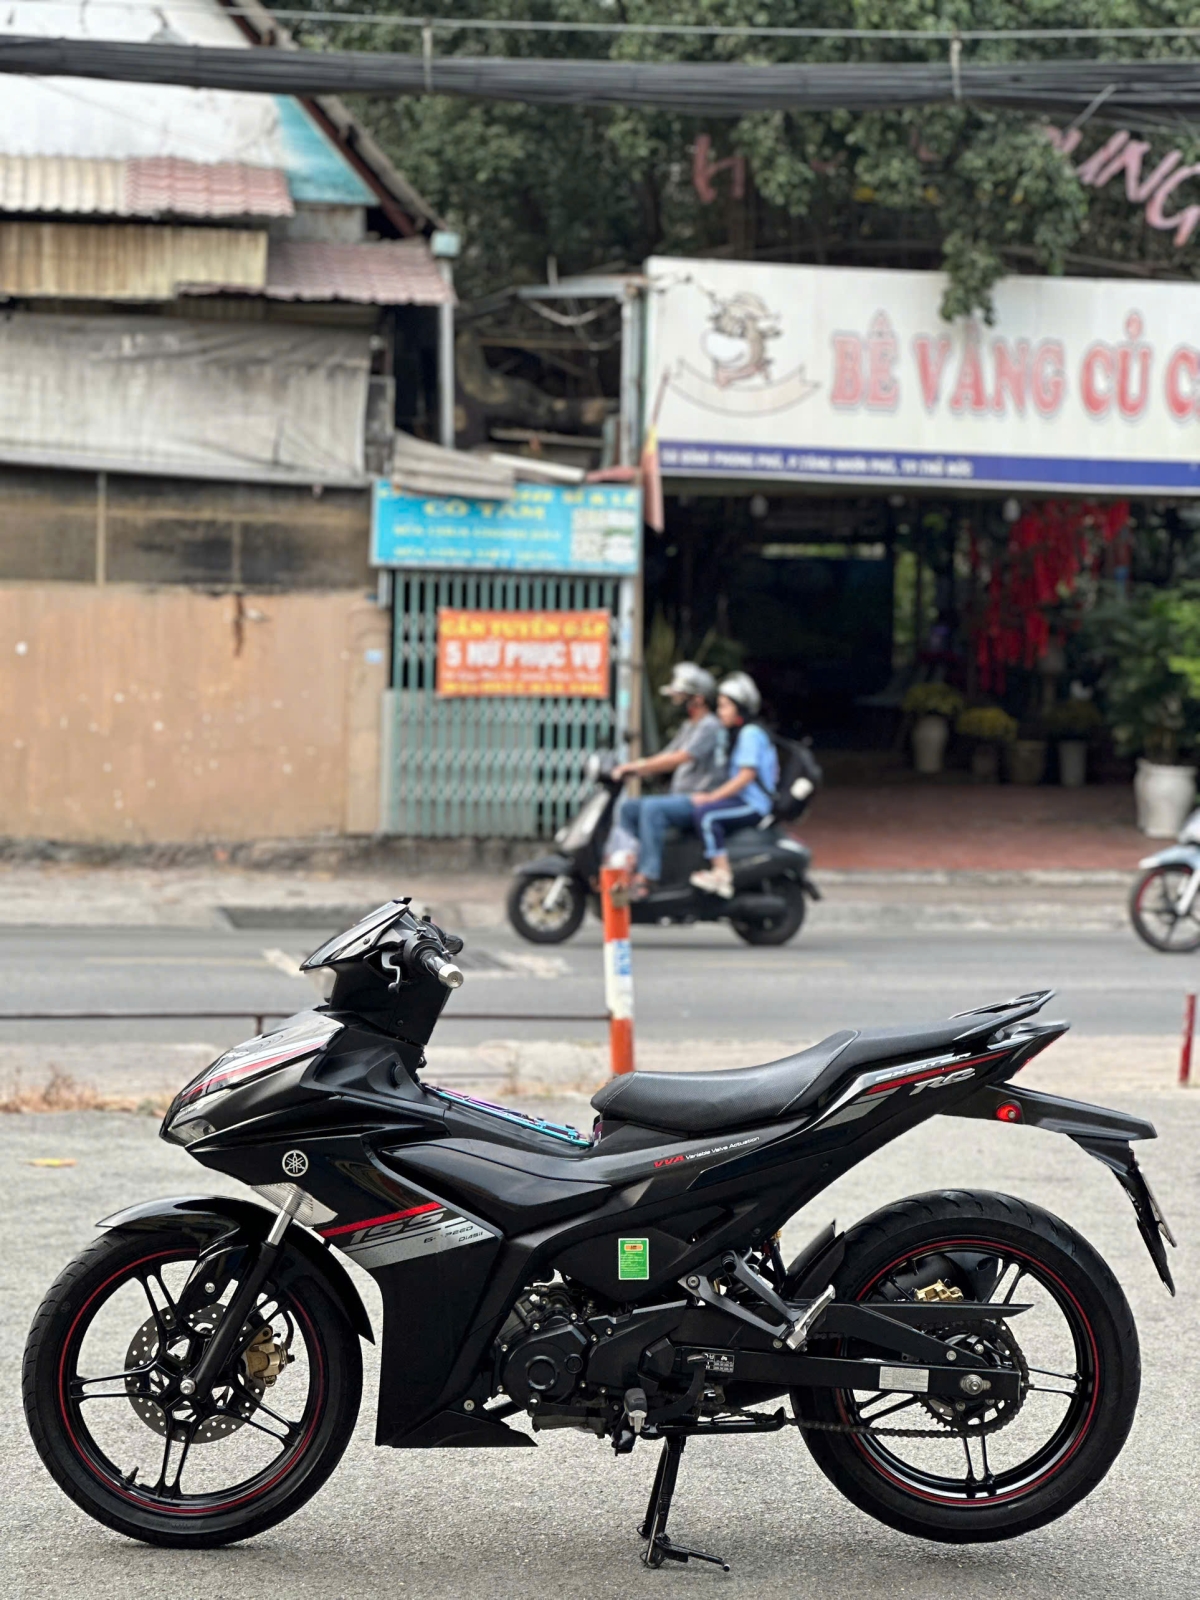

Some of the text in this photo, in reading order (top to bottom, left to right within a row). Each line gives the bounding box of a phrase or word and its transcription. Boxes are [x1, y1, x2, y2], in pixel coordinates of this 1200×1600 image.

[829, 310, 900, 410] BÊ
[1080, 312, 1152, 418] CỦ
[653, 1136, 760, 1169] VVA Variable Valve Actuation
